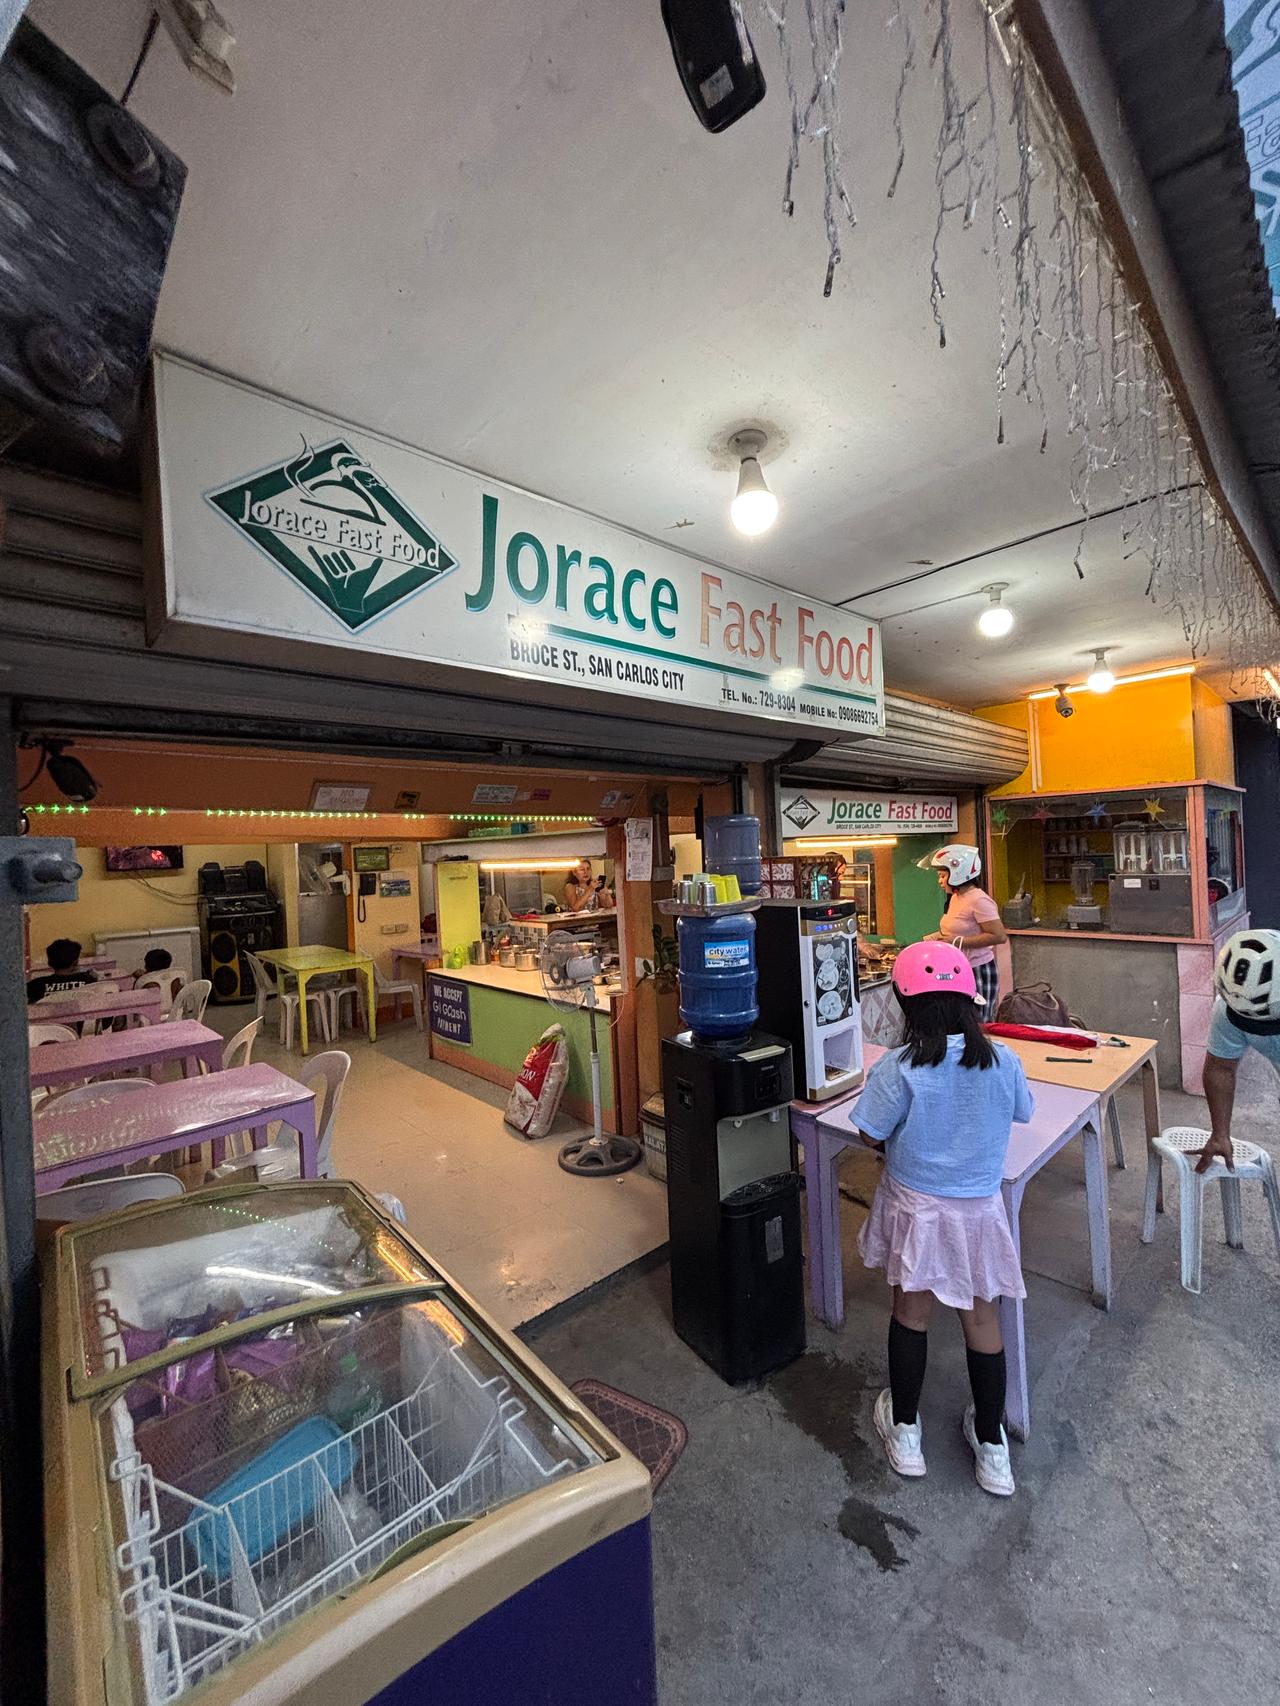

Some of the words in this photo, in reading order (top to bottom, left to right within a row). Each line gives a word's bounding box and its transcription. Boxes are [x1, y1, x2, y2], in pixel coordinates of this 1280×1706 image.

[239, 490, 328, 540] Jorace
[336, 519, 383, 554] Fast
[390, 534, 441, 568] Food
[464, 493, 679, 639] Jorace
[699, 572, 783, 665] Fast
[797, 606, 873, 688] Food
[510, 638, 559, 669] BROCE
[589, 654, 613, 679] SAN
[616, 660, 660, 687] CARLOS
[662, 669, 685, 692] CITY
[721, 687, 740, 702] TEL.
[759, 690, 796, 712] 729-8304
[800, 703, 826, 717] MOBILE
[827, 797, 882, 824] Jorace
[888, 800, 917, 820] Fast
[921, 801, 953, 820] Food
[709, 946, 724, 957] city
[433, 984, 442, 998] WE
